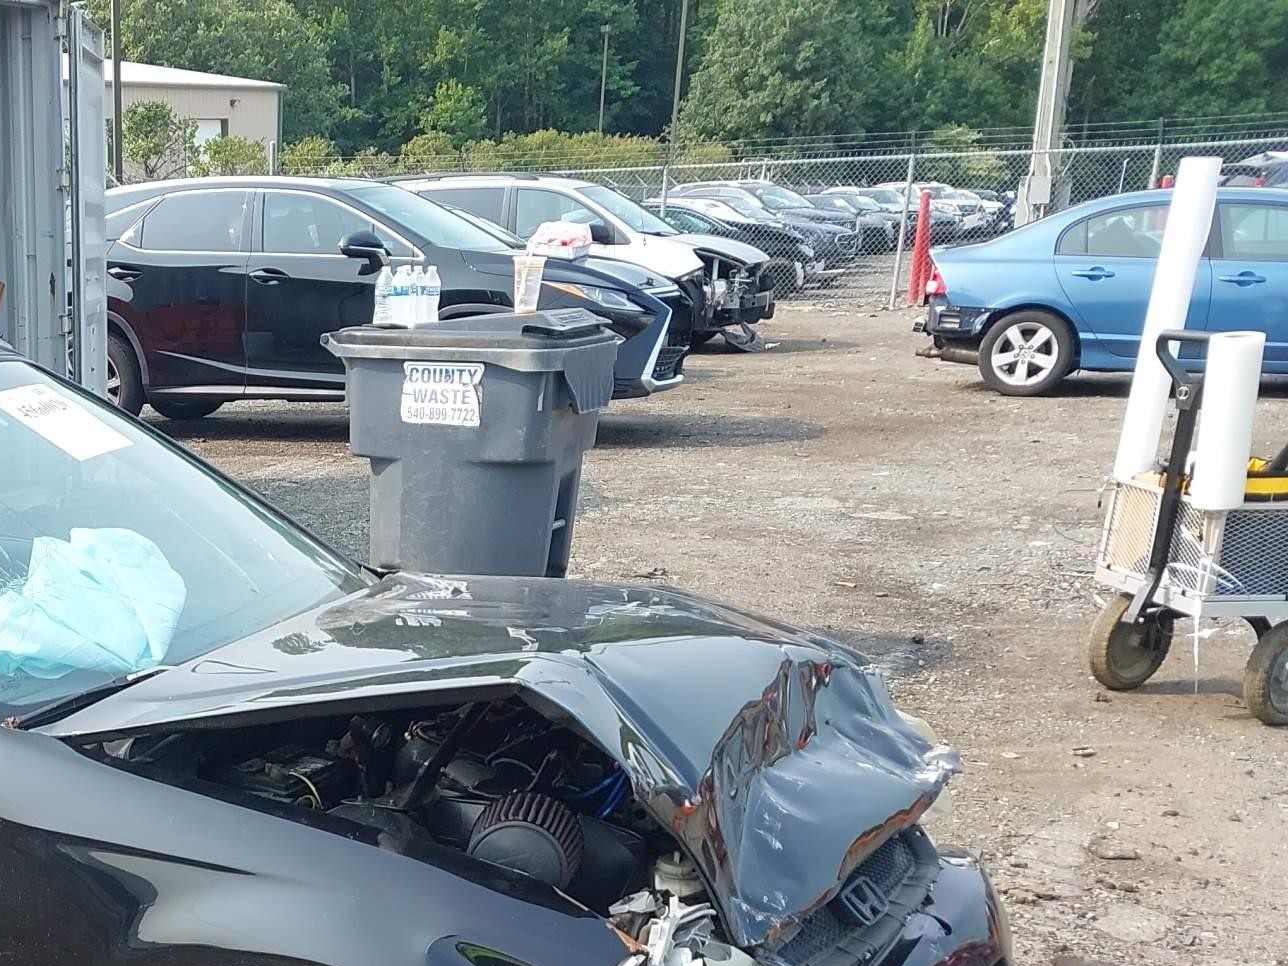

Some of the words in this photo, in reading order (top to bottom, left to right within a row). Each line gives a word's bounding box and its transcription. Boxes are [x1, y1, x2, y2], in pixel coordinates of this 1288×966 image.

[408, 367, 479, 384] COUNTY
[413, 388, 472, 405] WASTE
[407, 406, 476, 422] 540-899-7722
